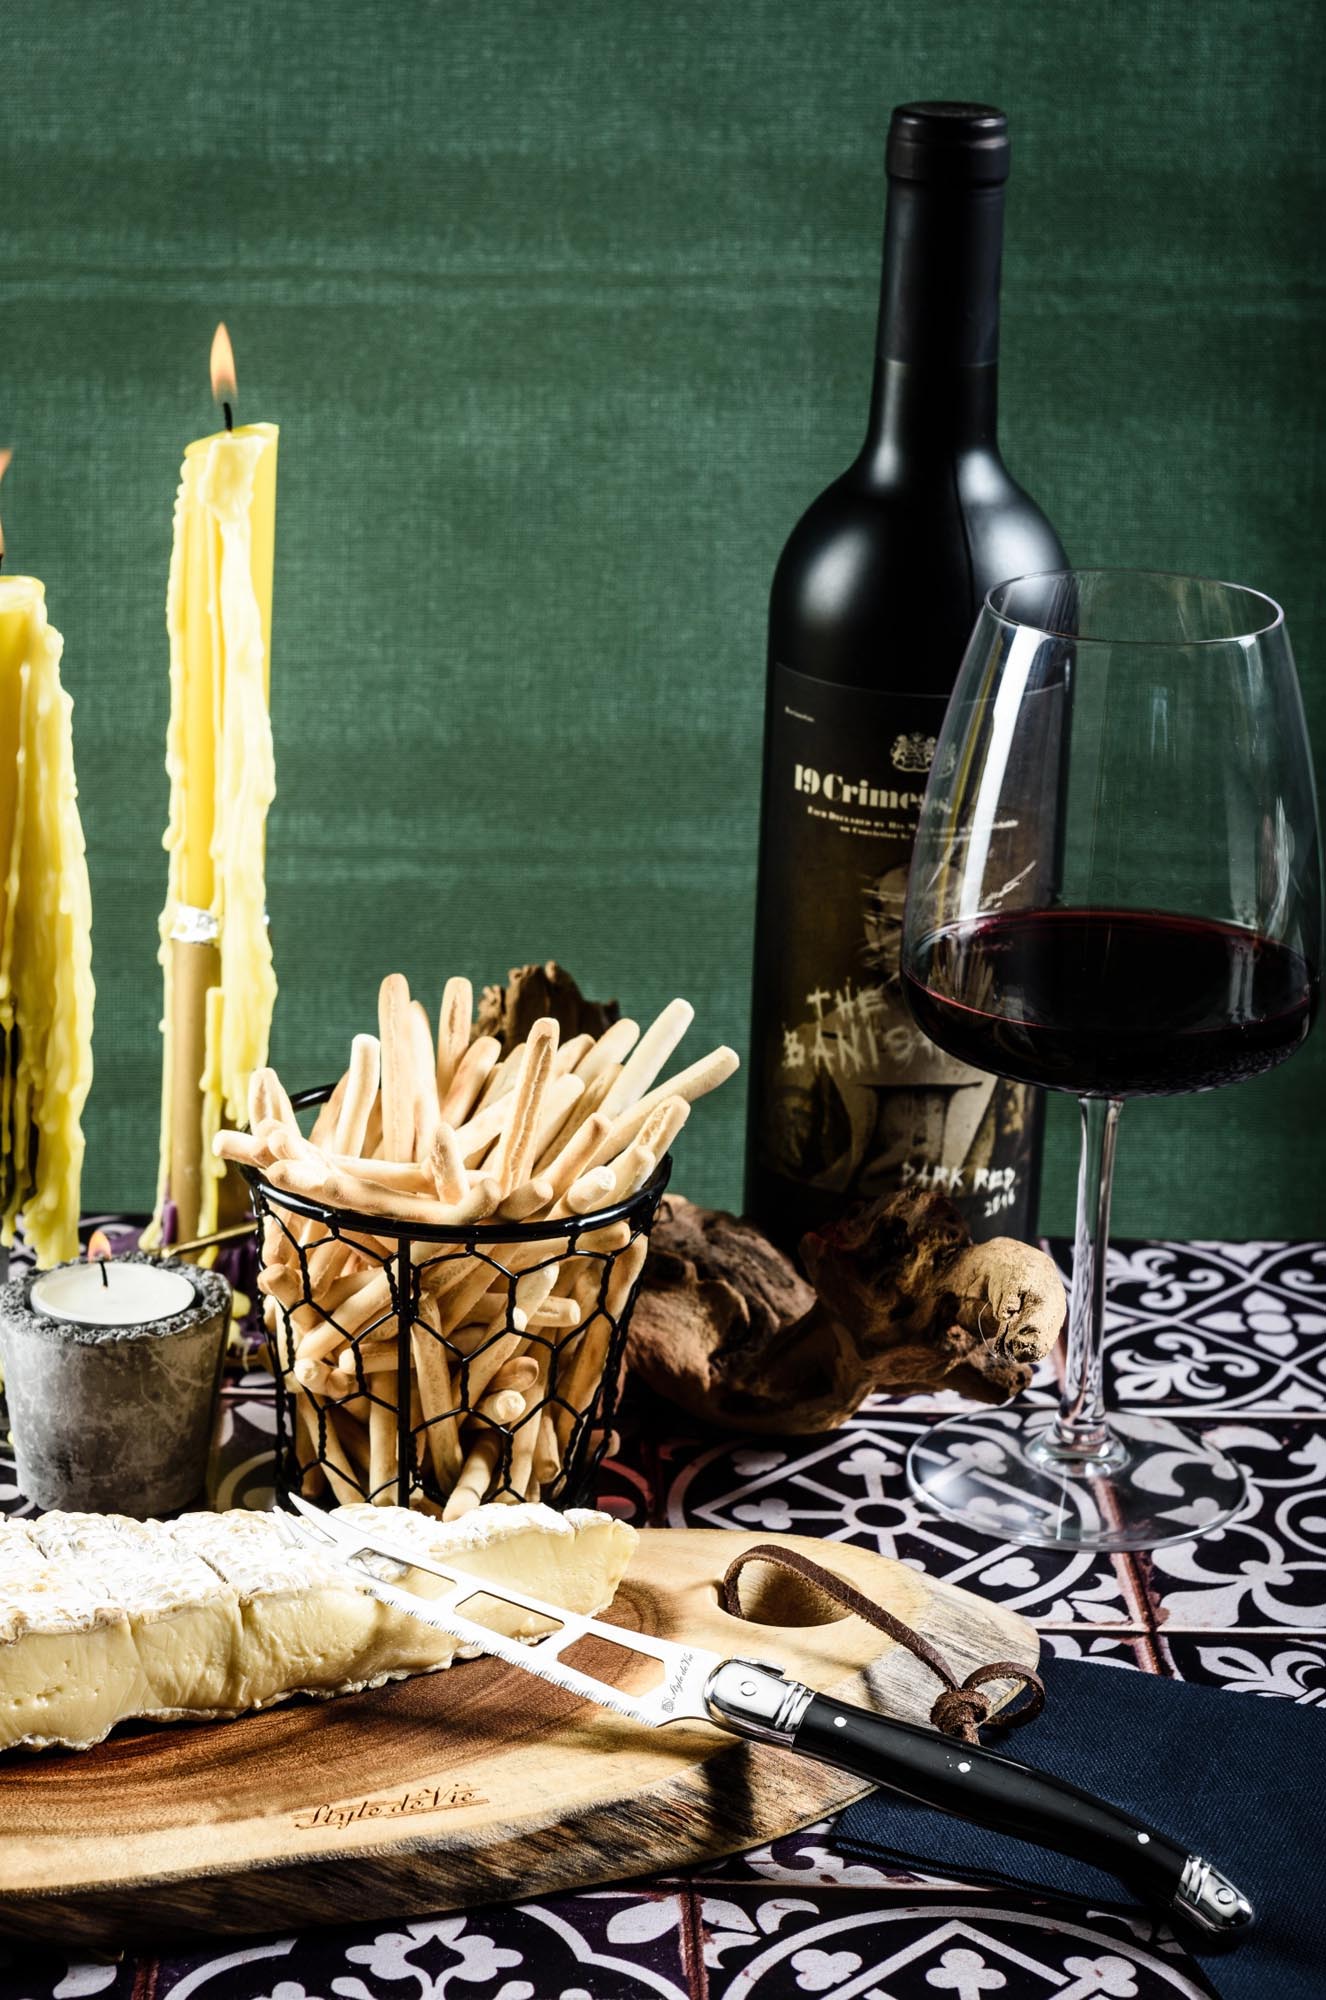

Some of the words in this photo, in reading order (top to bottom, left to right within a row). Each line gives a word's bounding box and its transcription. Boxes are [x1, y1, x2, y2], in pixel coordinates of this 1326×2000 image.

[794, 763, 821, 796] 19
[806, 976, 888, 1023] THE
[902, 1160, 966, 1195] DARK
[294, 1800, 382, 1830] Style
